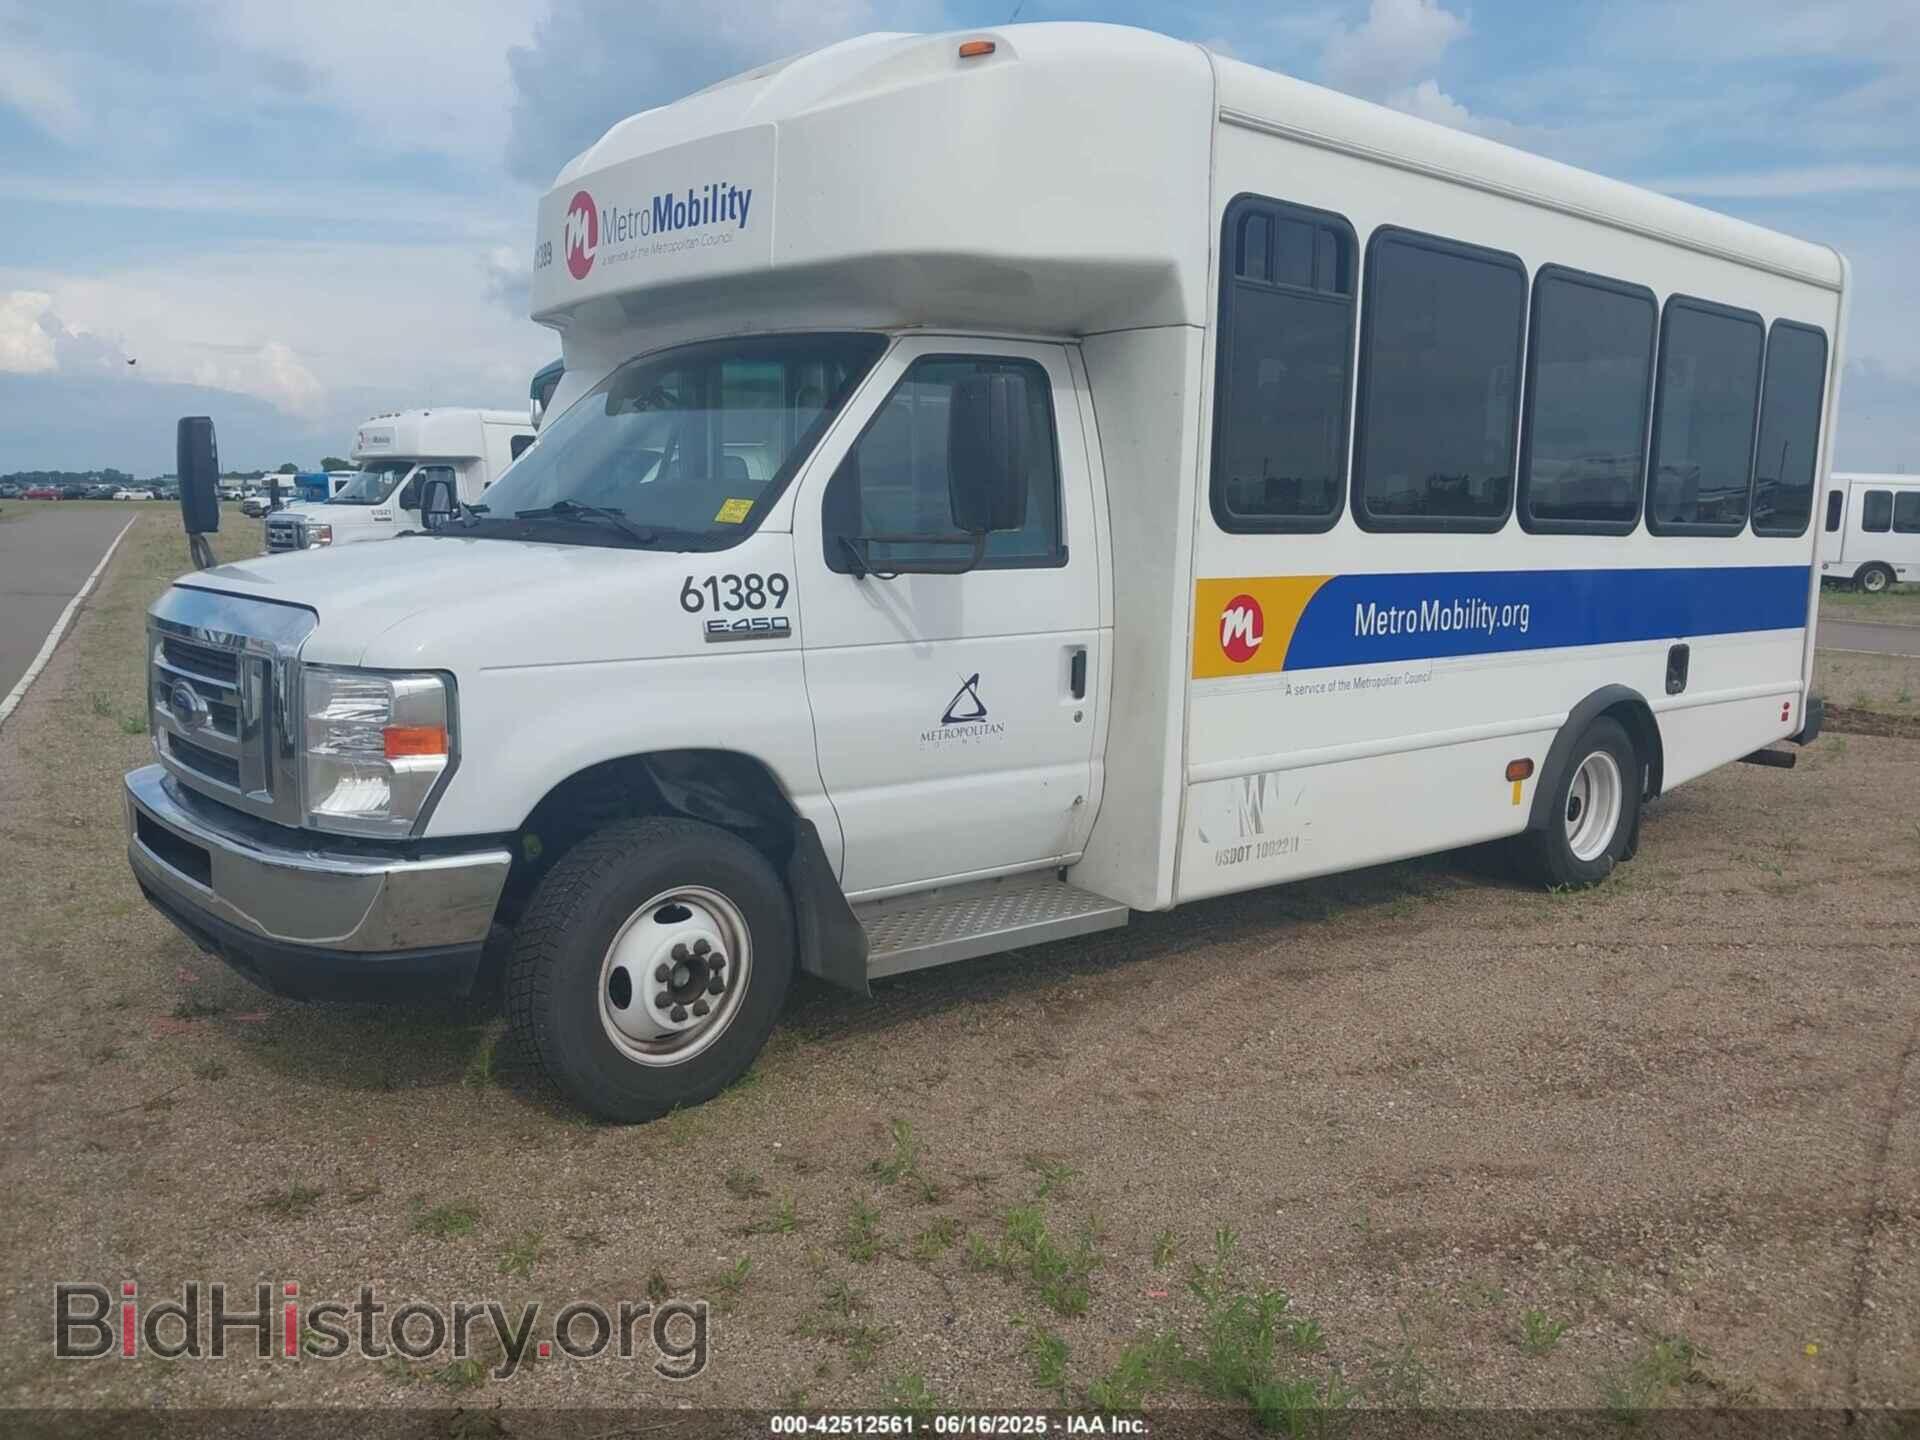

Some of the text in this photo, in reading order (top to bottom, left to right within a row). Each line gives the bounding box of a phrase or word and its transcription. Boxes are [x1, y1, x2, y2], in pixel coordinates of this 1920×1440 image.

[679, 573, 789, 613] 61389
[706, 616, 790, 634] E-450
[1285, 670, 1433, 696] A service of the Metropolitan Council
[920, 721, 1005, 742] METROPOLITAN
